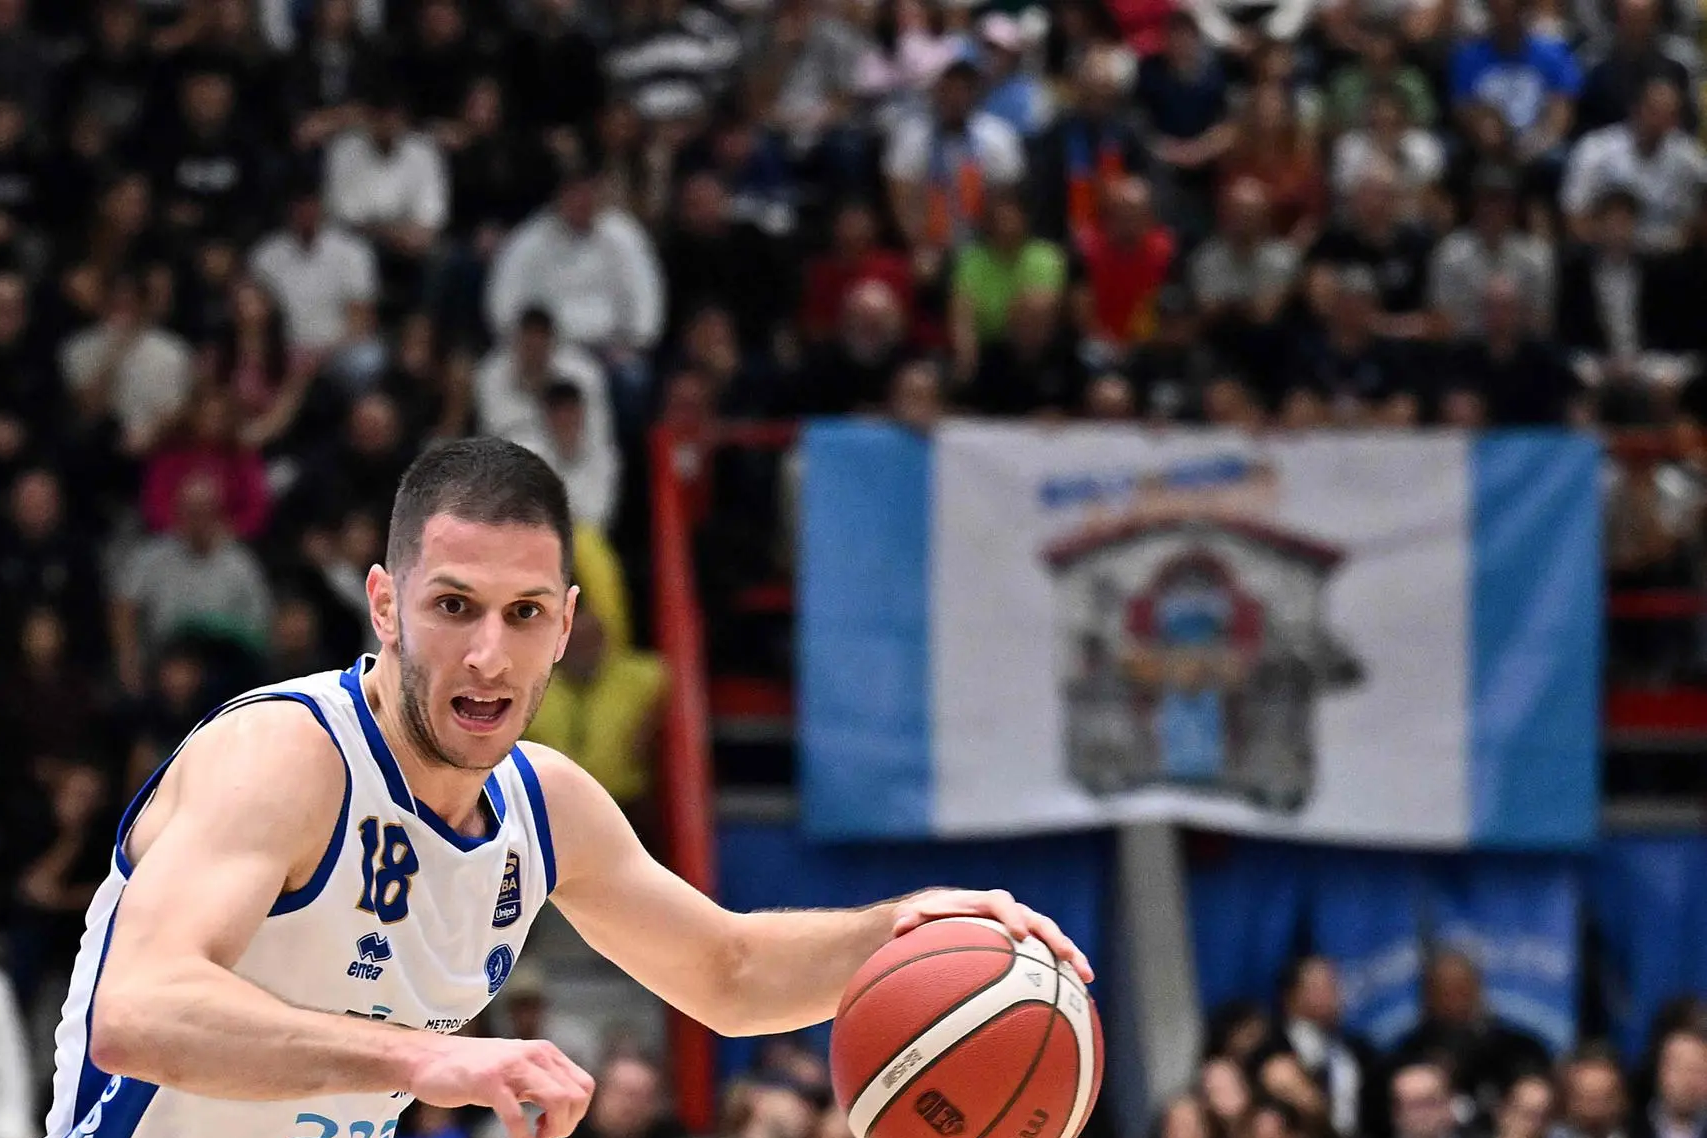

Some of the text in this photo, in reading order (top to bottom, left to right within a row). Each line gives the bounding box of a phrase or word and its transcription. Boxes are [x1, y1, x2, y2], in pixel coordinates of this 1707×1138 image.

[355, 815, 419, 925] 18
[500, 876, 517, 894] BA
[495, 904, 517, 920] Unipol
